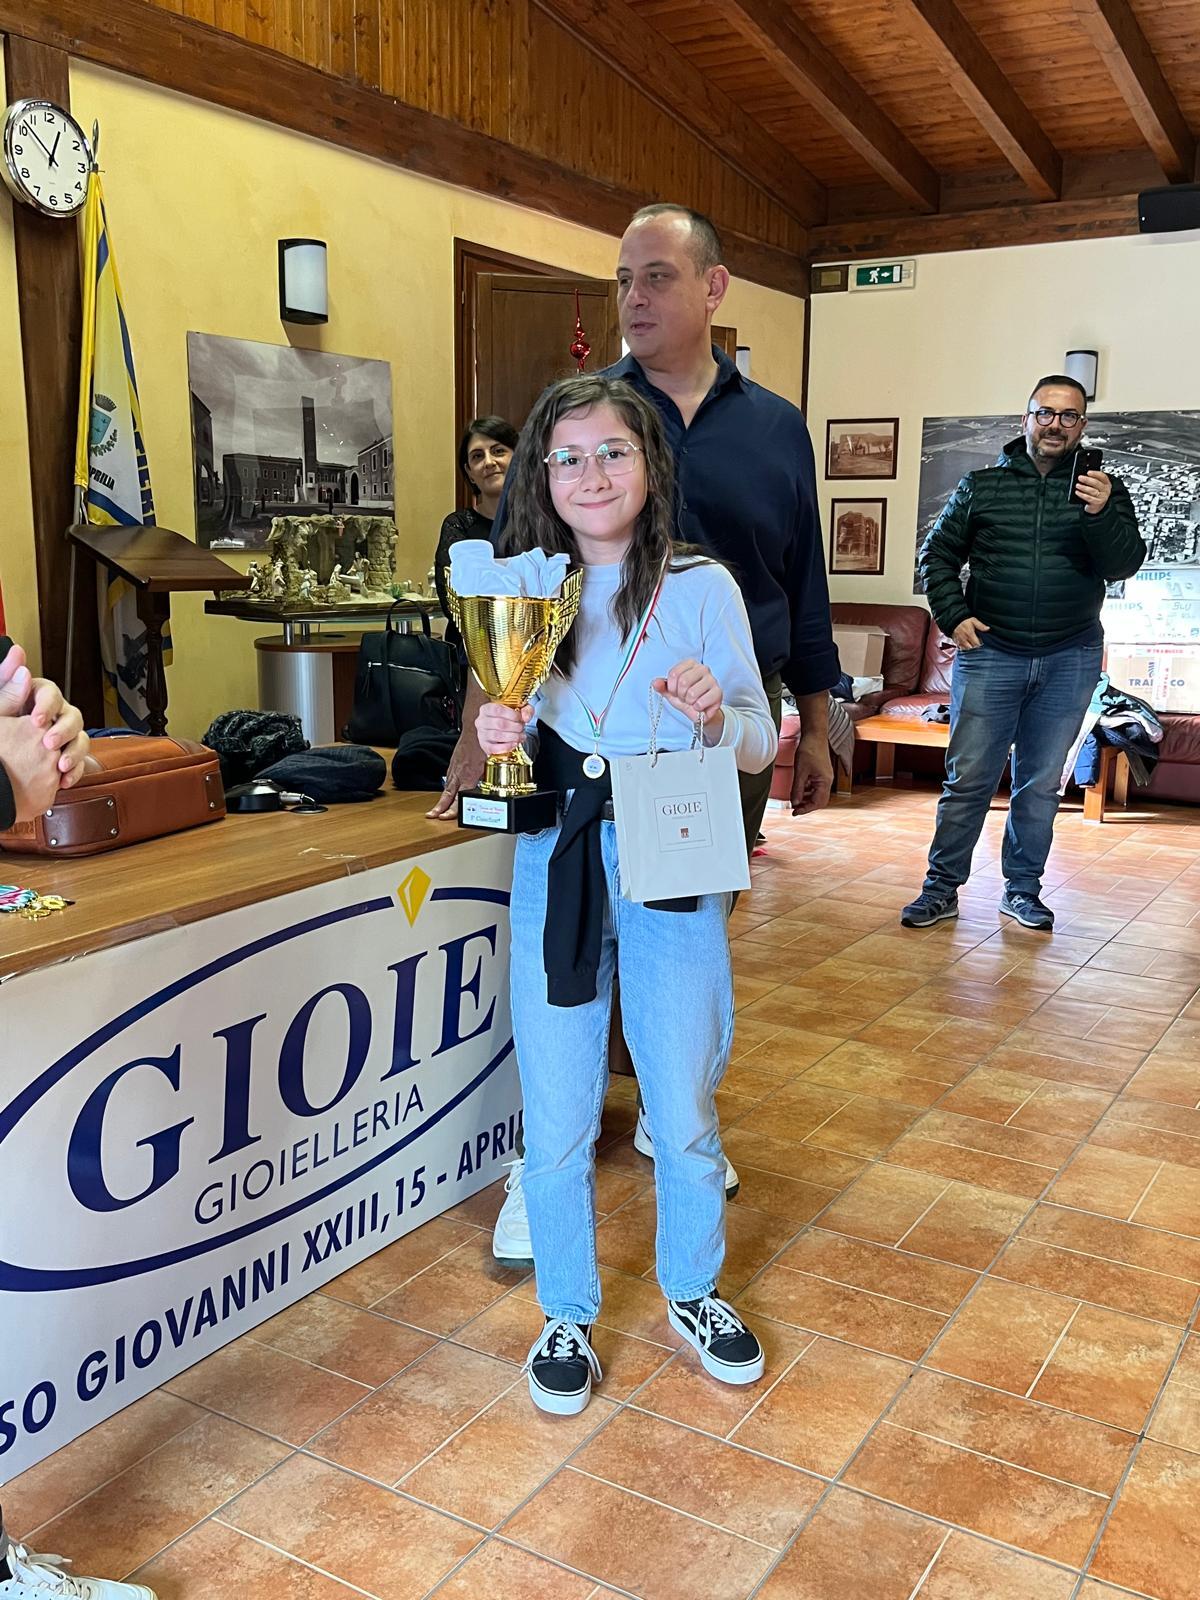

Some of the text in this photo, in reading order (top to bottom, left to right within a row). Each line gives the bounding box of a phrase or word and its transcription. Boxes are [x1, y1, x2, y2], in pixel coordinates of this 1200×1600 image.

[30, 114, 37, 126] 11
[44, 111, 55, 124] 12
[19, 124, 28, 136] 10
[63, 122, 67, 132] 1
[14, 144, 23, 156] 9
[72, 140, 80, 151] 2
[21, 167, 30, 179] 8
[77, 162, 86, 173] 3
[33, 185, 41, 197] 7
[74, 181, 82, 191] 4
[49, 195, 58, 206] 6
[64, 193, 73, 204] 5
[662, 801, 702, 816] GIOIE
[67, 924, 498, 1213] GIOIE
[194, 1083, 424, 1225] GIOIELLERIA
[76, 1241, 290, 1402] GIOVANNI
